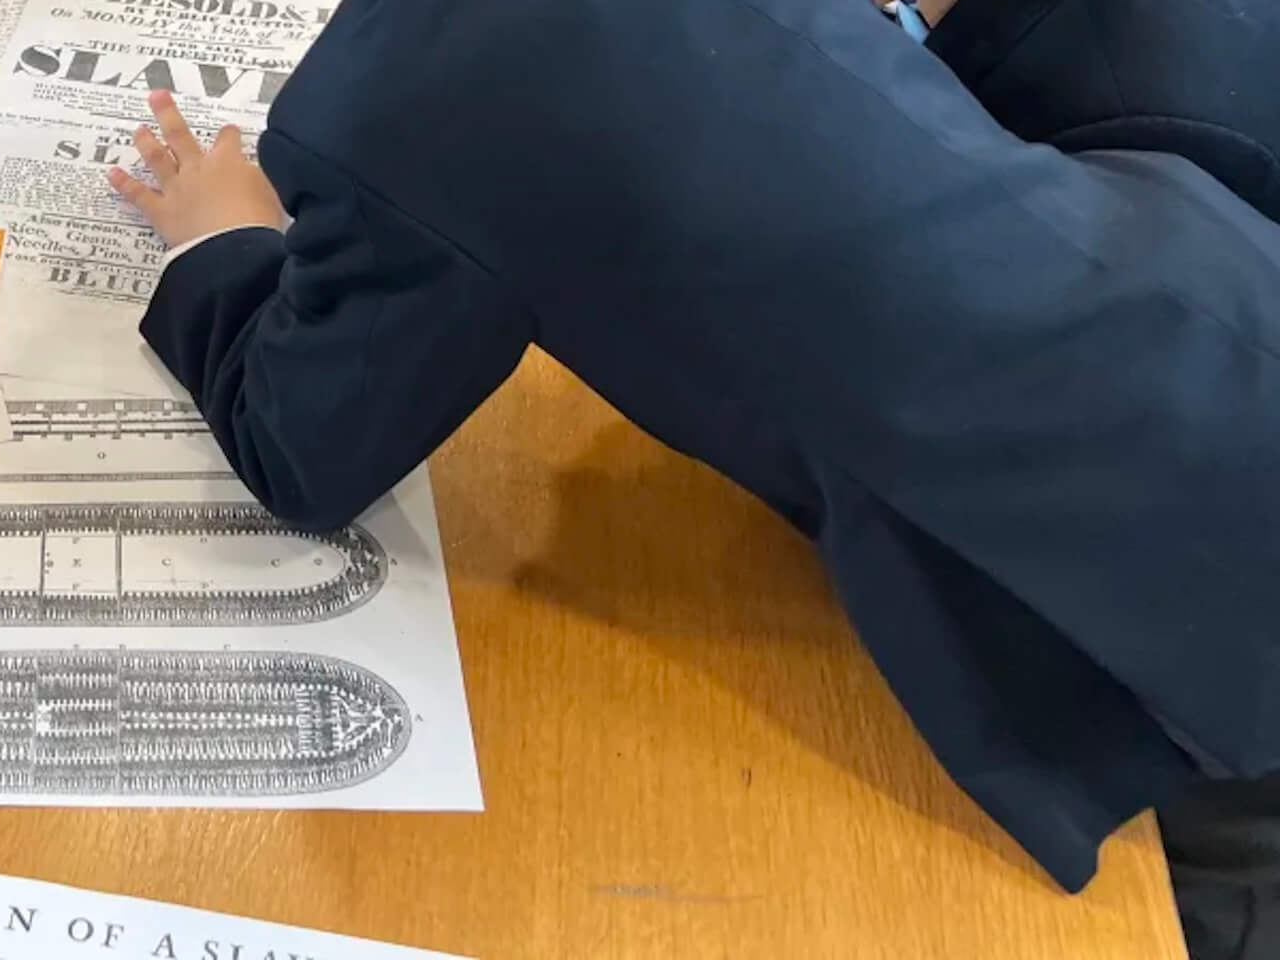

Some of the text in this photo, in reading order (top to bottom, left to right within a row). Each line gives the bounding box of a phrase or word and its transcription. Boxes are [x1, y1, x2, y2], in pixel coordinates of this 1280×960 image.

[81, 8, 175, 28] MONDAY
[178, 22, 201, 32] the
[279, 3, 308, 22] &
[88, 40, 131, 53] THE
[210, 52, 296, 69] FOLLOW
[8, 222, 49, 239] Rice,
[28, 214, 62, 227] Also
[6, 235, 80, 256] Needles,
[87, 244, 132, 262] Pins,
[48, 266, 152, 295] BLUC
[67, 916, 125, 949] OF
[151, 932, 177, 959] A
